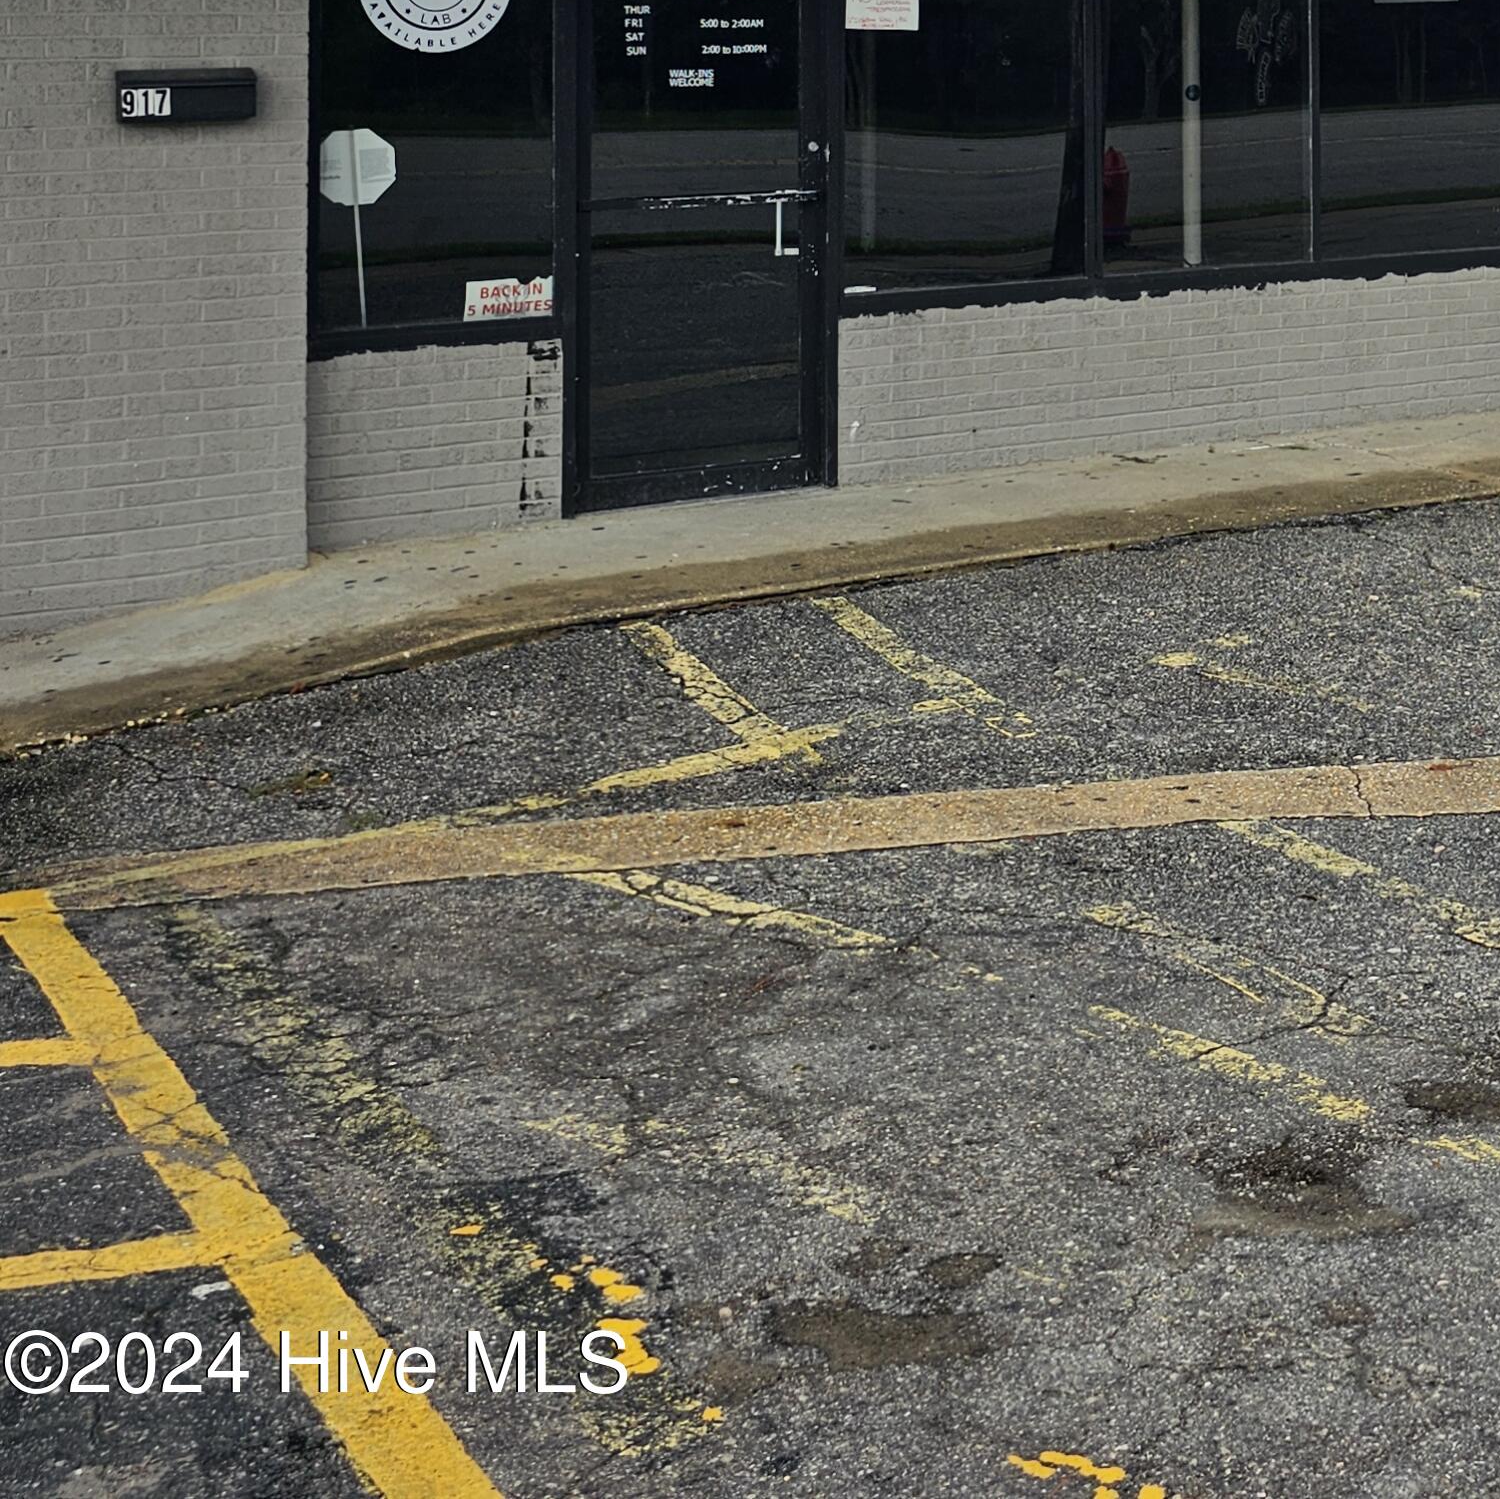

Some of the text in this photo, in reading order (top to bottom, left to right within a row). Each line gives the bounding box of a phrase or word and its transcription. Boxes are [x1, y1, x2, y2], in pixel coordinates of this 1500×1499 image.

[624, 5, 650, 15] THUR
[369, 1, 501, 47] AVAILABLE HERE
[420, 13, 451, 25] LAB
[624, 18, 643, 28] FRI
[700, 19, 718, 28] 5:00
[720, 19, 729, 28] to
[625, 32, 645, 42] SAT
[626, 46, 647, 55] SUN
[701, 45, 720, 54] 2:00
[722, 45, 731, 54] to
[669, 69, 714, 78] WALK-INS
[669, 78, 714, 87] WELCOME
[122, 89, 167, 116] 917
[480, 283, 543, 299] BACK IN
[467, 299, 553, 316] 5 MINUTES
